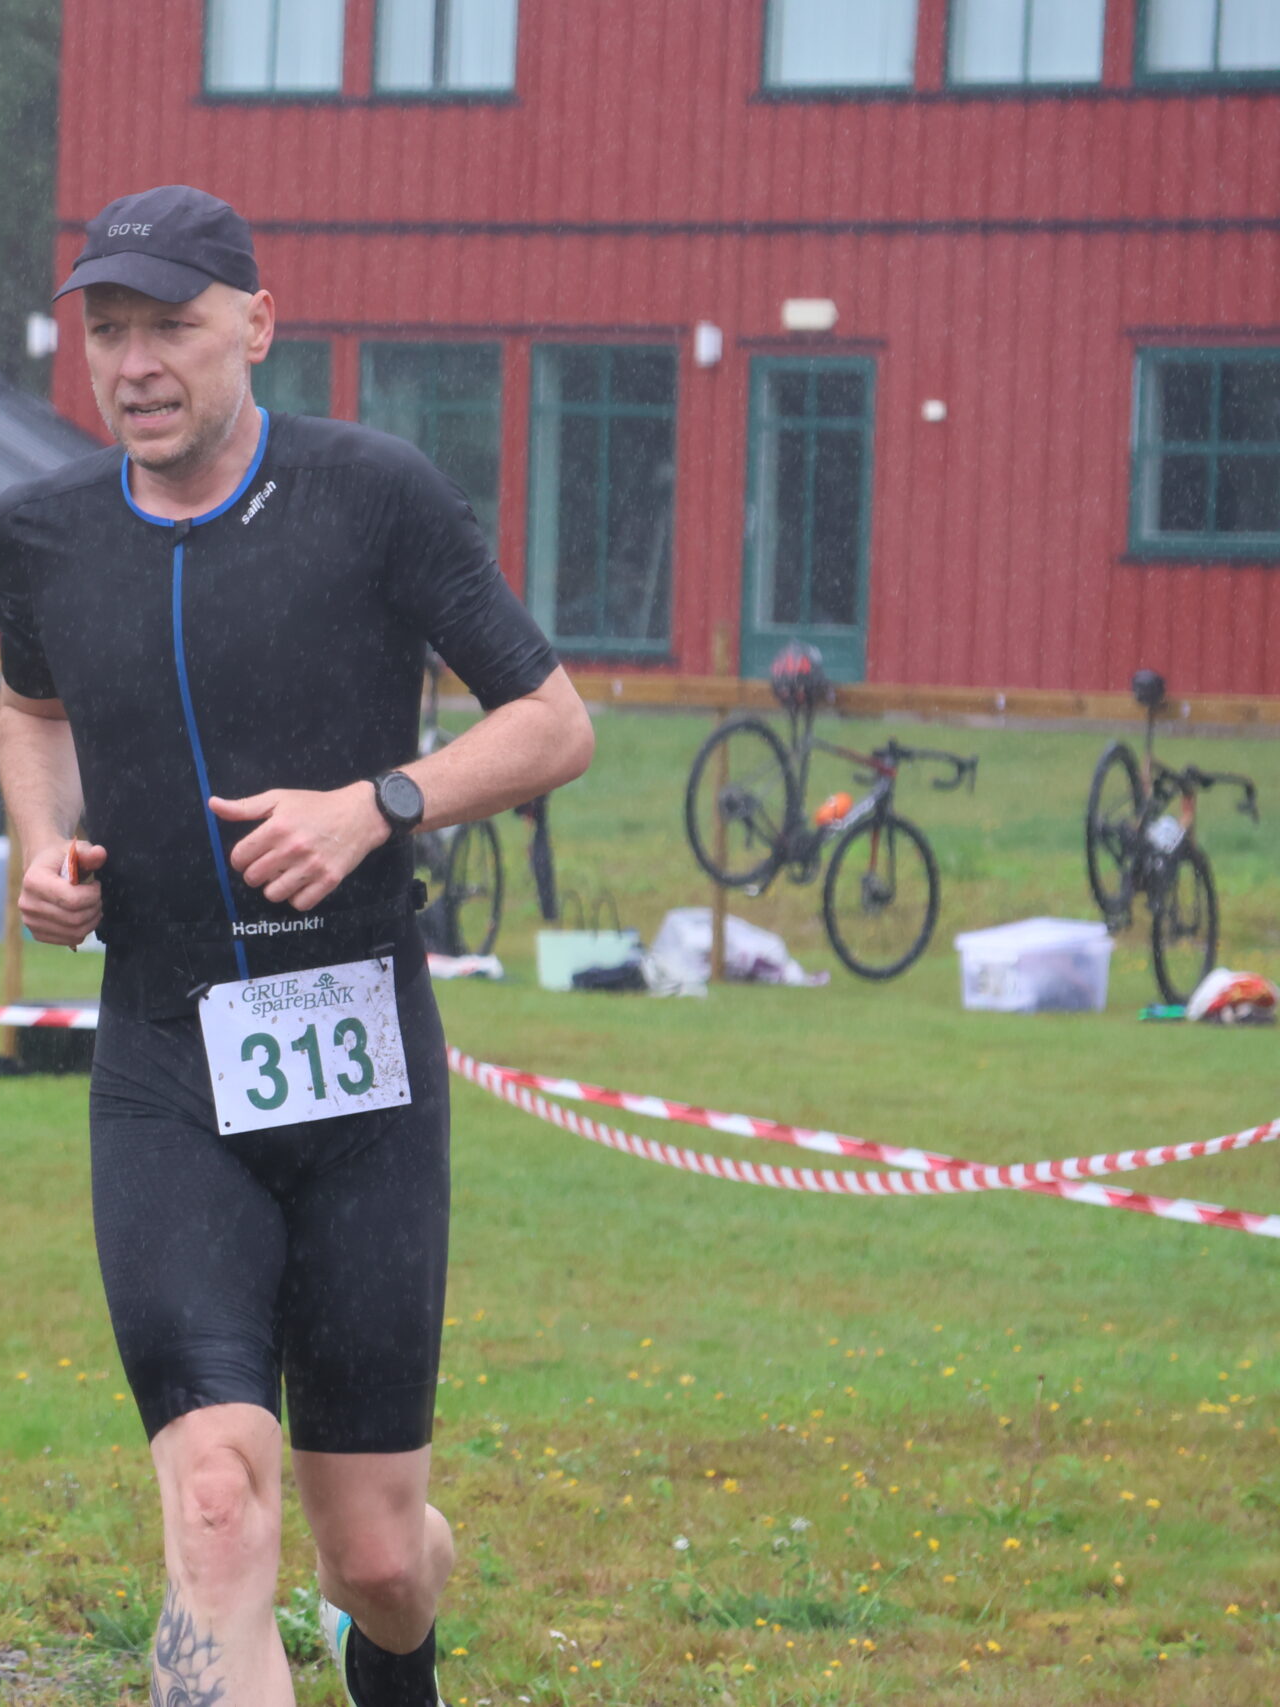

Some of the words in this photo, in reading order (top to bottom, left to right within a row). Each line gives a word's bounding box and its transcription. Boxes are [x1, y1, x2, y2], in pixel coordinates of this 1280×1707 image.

[108, 223, 153, 237] GORE
[241, 480, 277, 525] sailfish
[242, 980, 299, 1003] GRUE
[251, 987, 355, 1018] spareBANK
[241, 1017, 375, 1111] 313
